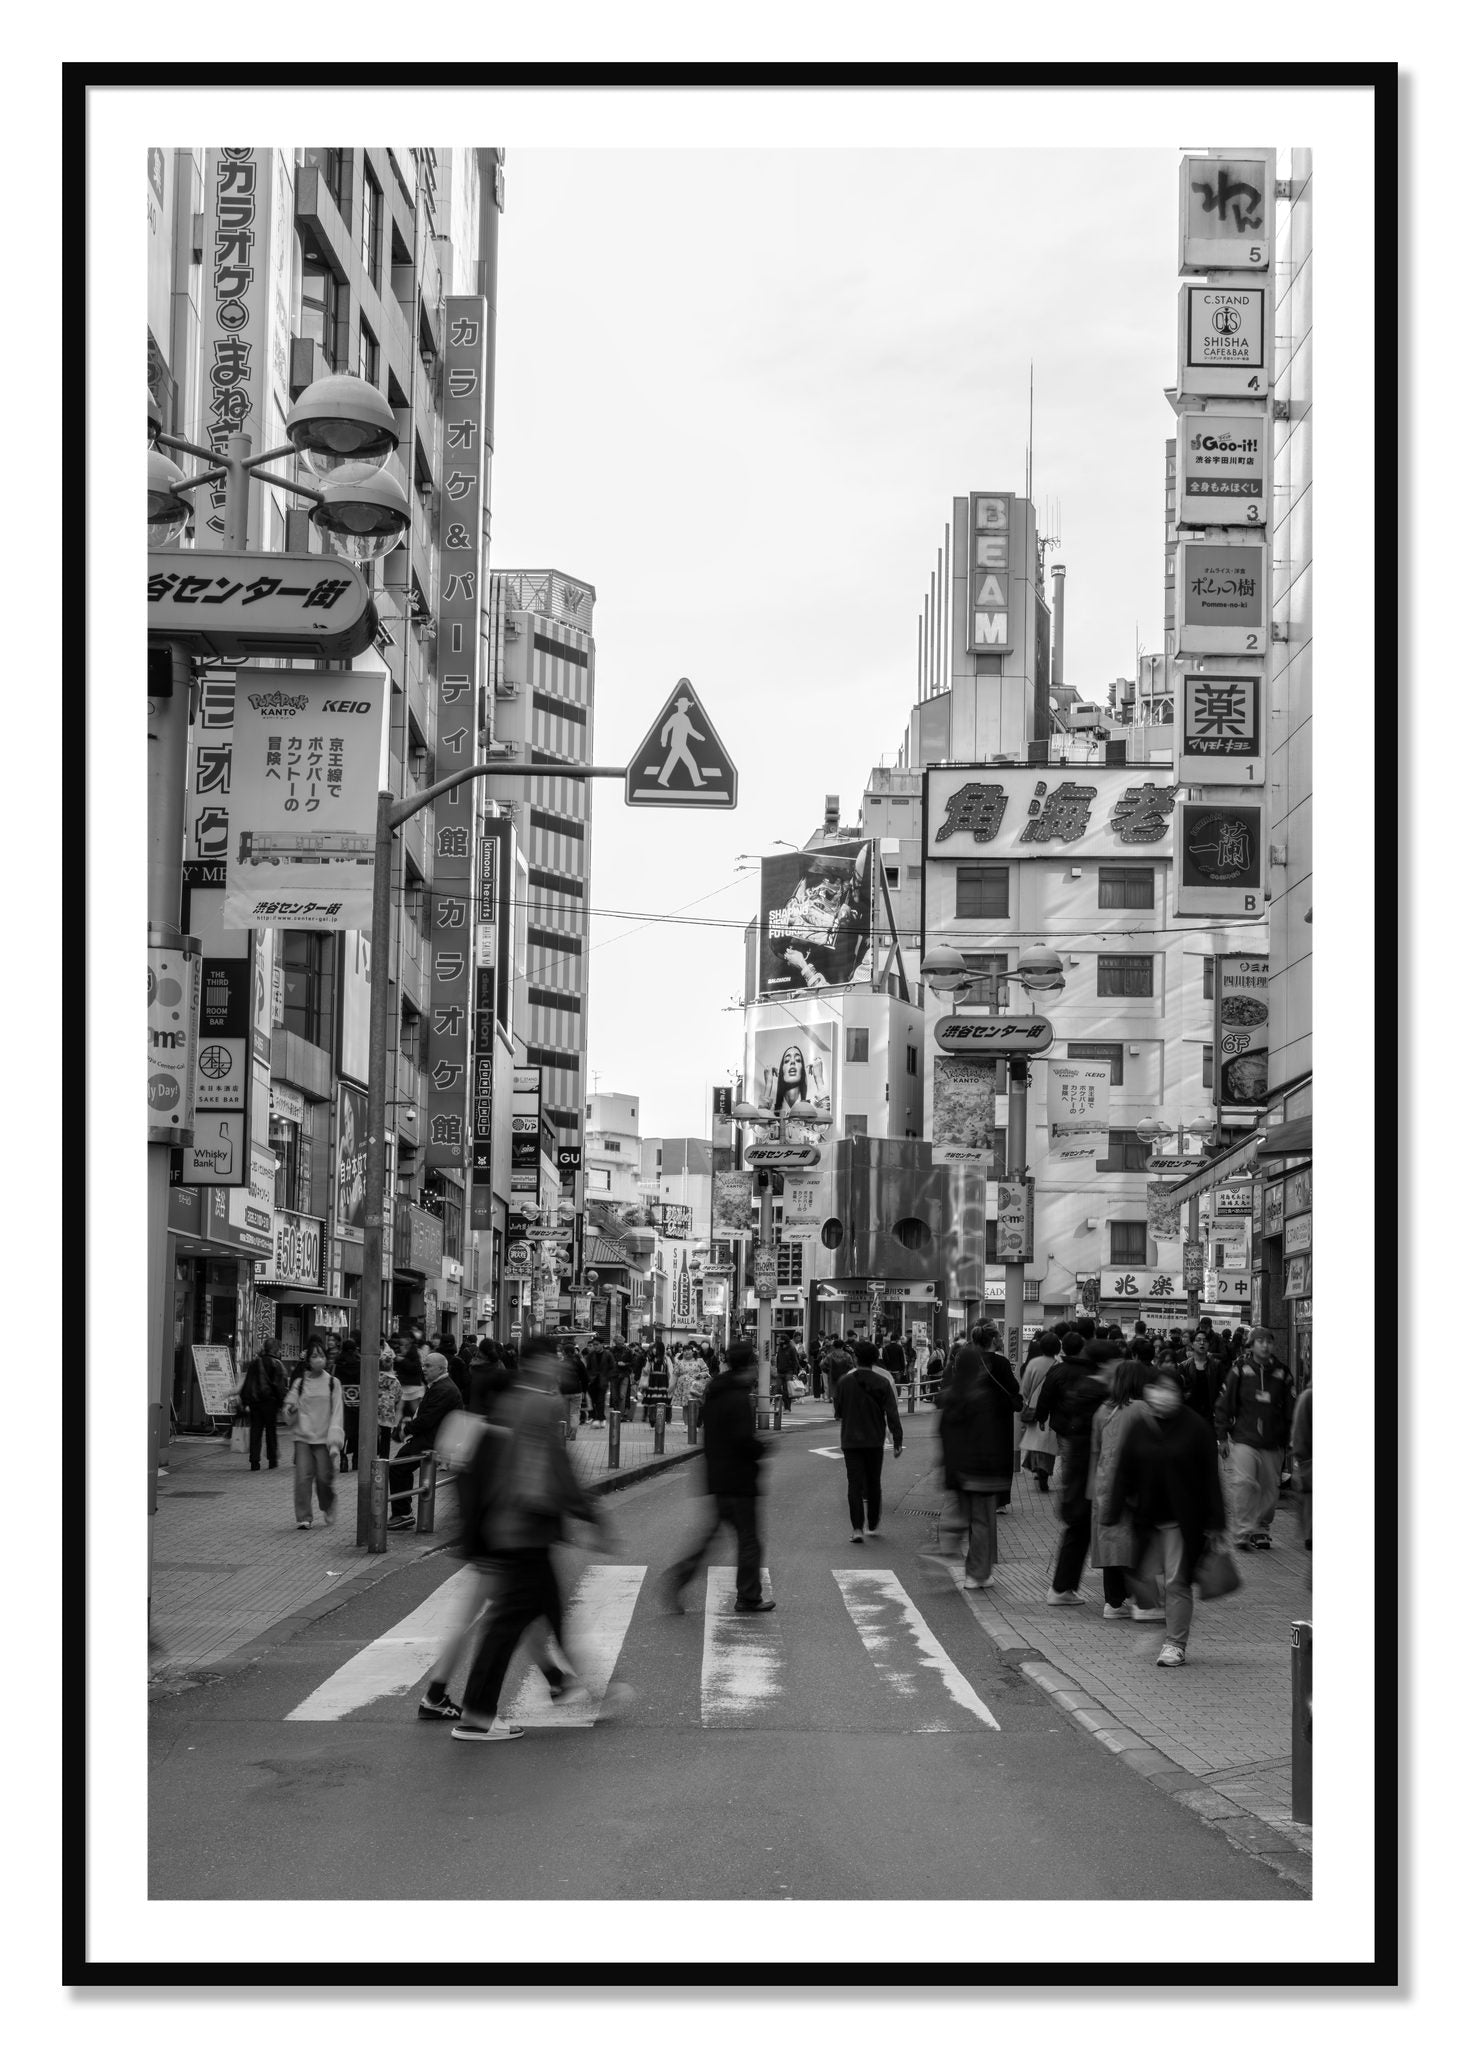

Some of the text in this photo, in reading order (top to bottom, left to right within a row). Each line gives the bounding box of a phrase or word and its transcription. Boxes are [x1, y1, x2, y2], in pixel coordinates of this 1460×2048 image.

[214, 157, 256, 301] カラオケ
[1250, 247, 1261, 262] 5
[1204, 295, 1250, 305] C.STAND
[1204, 336, 1249, 348] SHISHA
[1248, 375, 1260, 391] 4
[1202, 436, 1258, 452] Goo-it!
[1195, 456, 1254, 466] 渋谷宇田川町店
[1190, 481, 1259, 493] 全身もみほぐし
[1247, 505, 1259, 521] 3
[975, 498, 1008, 645] BEAM
[1246, 634, 1258, 649] 2
[261, 708, 296, 716] KANTO
[322, 700, 371, 714] KEIO
[1194, 683, 1246, 735] 薬
[1189, 738, 1251, 753] マツモトキヨシ
[265, 736, 282, 780] 冒険へ
[284, 736, 302, 812] カントーの
[305, 736, 324, 812] ポケパーク
[326, 737, 344, 798] 京王線で
[1245, 765, 1254, 780] 1
[935, 781, 1180, 844] 角海老
[1189, 821, 1251, 871] 一蘭
[253, 902, 343, 915] 渋谷センター街
[1244, 895, 1256, 911] B
[942, 1025, 1046, 1038] 渋谷センター街
[1221, 1034, 1250, 1054] 6F
[159, 1084, 178, 1098] Day!
[524, 1123, 537, 1131] UP
[194, 1150, 228, 1160] Whisky
[560, 1153, 580, 1163] GU
[193, 1159, 214, 1168] Bank
[679, 1272, 690, 1316] BEER
[677, 1317, 691, 1325] HALL
